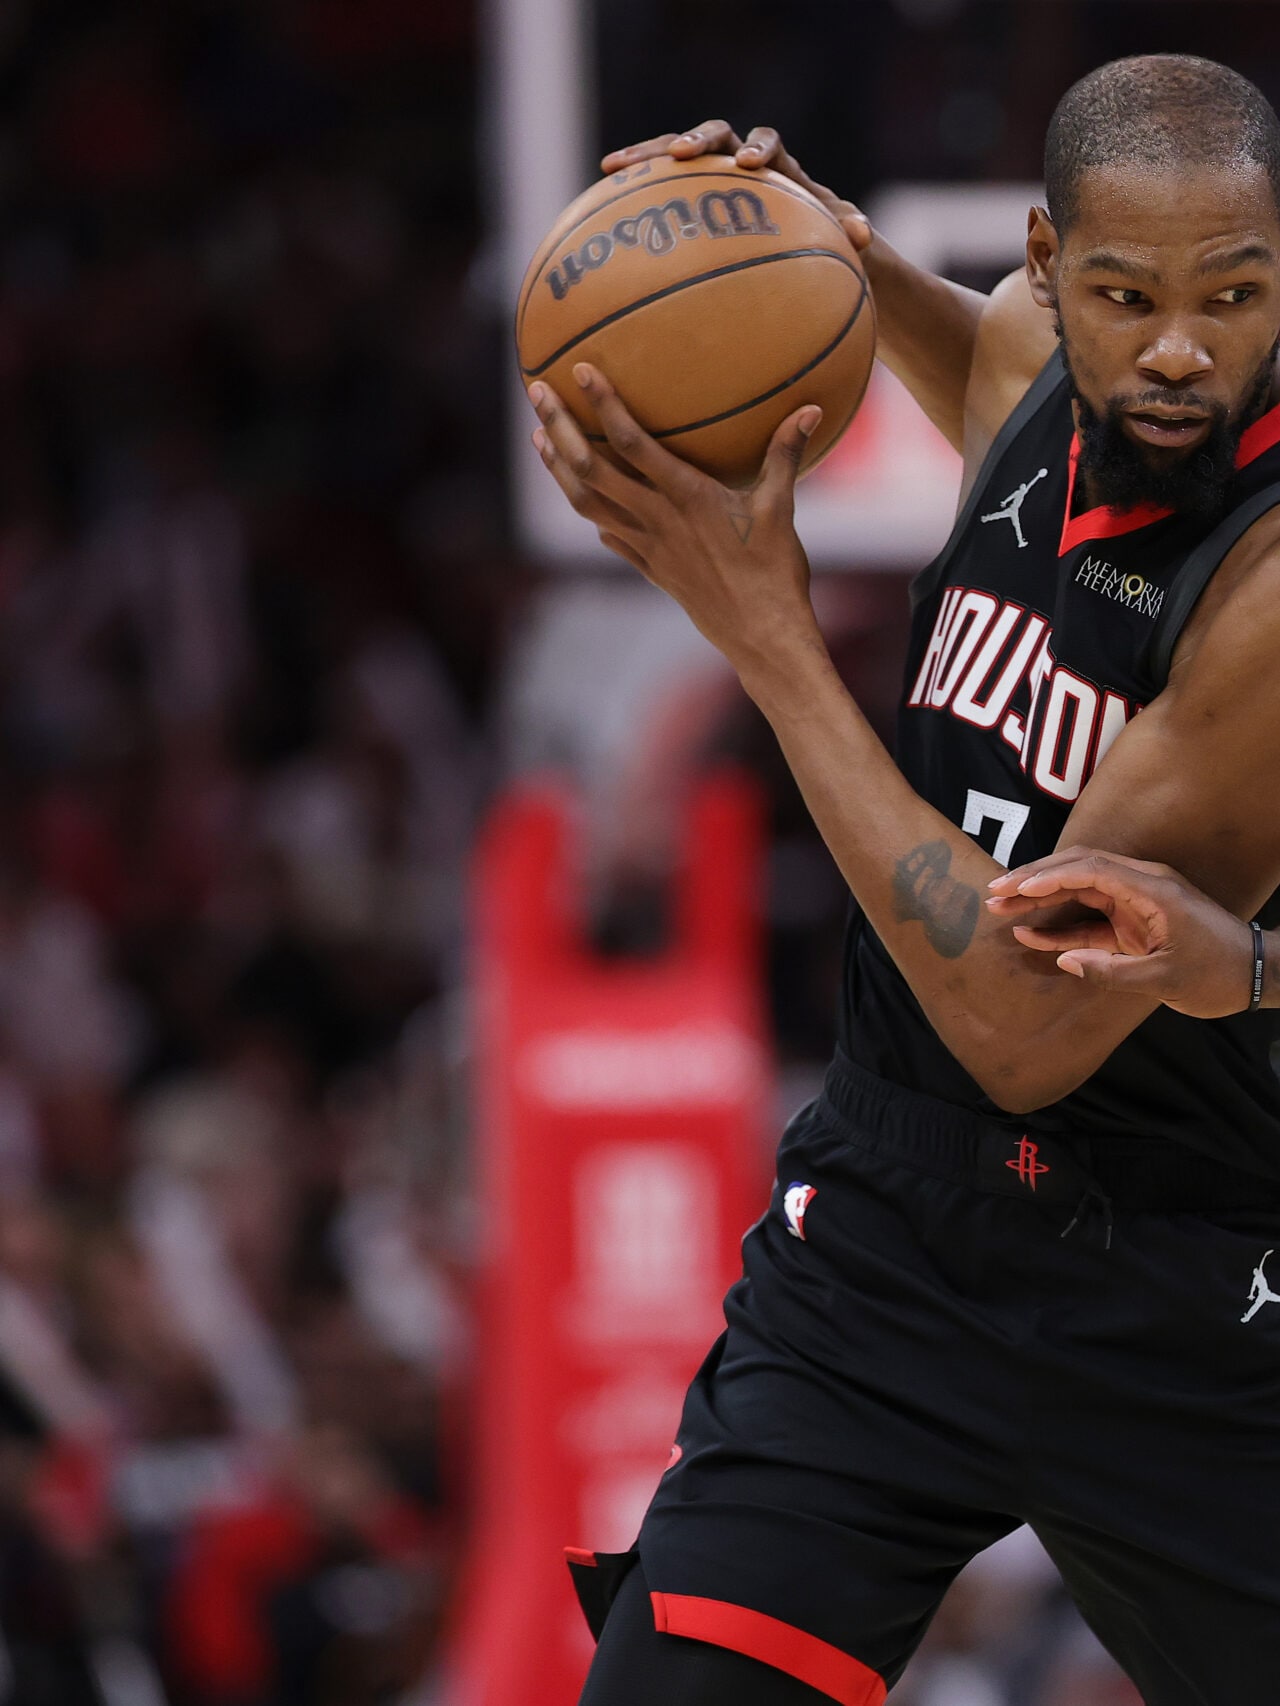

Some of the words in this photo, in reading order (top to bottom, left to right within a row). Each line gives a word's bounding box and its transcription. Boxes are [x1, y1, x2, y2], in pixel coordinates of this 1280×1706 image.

[544, 188, 781, 300] Wilson
[1080, 555, 1165, 605] MEMORIA
[962, 788, 1030, 869] 7
[1255, 959, 1263, 978] PERSON
